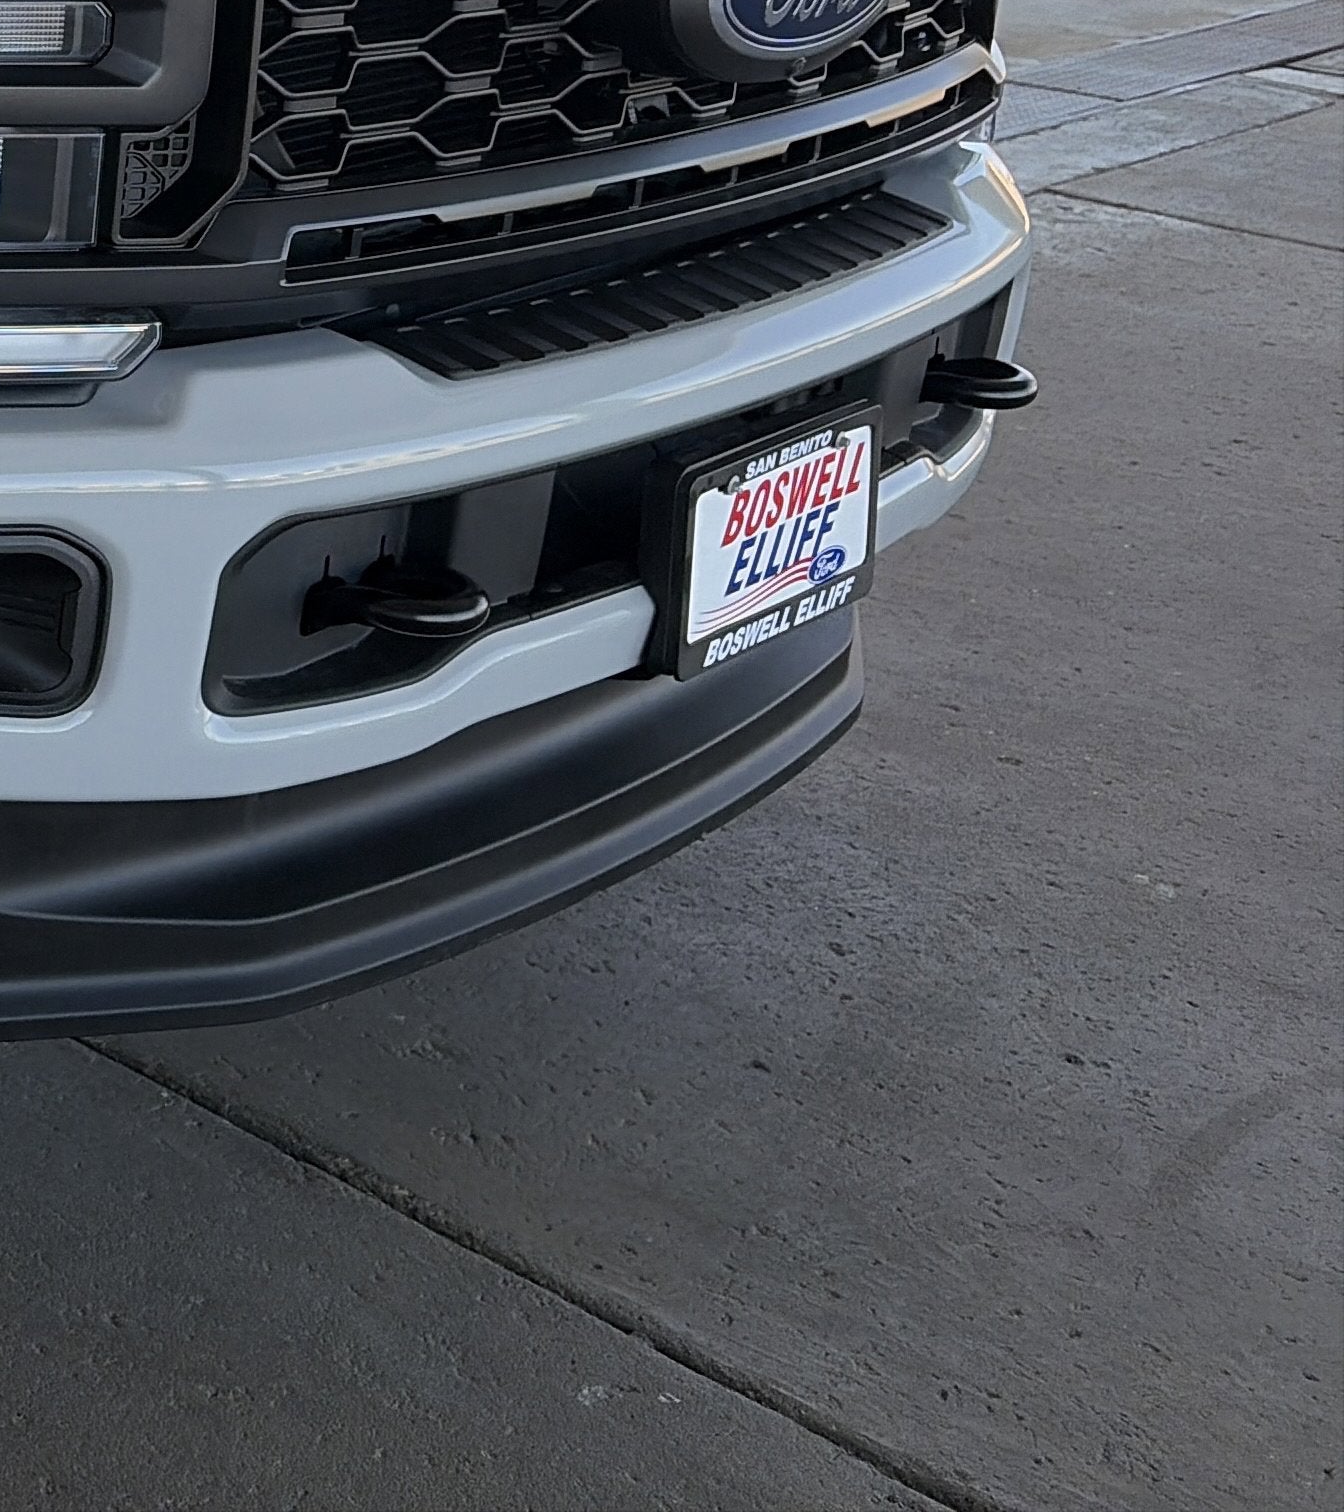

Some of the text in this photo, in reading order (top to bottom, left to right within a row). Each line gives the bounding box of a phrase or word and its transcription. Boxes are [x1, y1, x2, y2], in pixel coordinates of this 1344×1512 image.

[721, 441, 865, 548] BOSWELL
[746, 429, 833, 479] SAN BENITO
[724, 502, 839, 597] ELLIFF
[813, 551, 842, 580] Ford
[702, 577, 855, 668] BOSWELL ELLIFF
